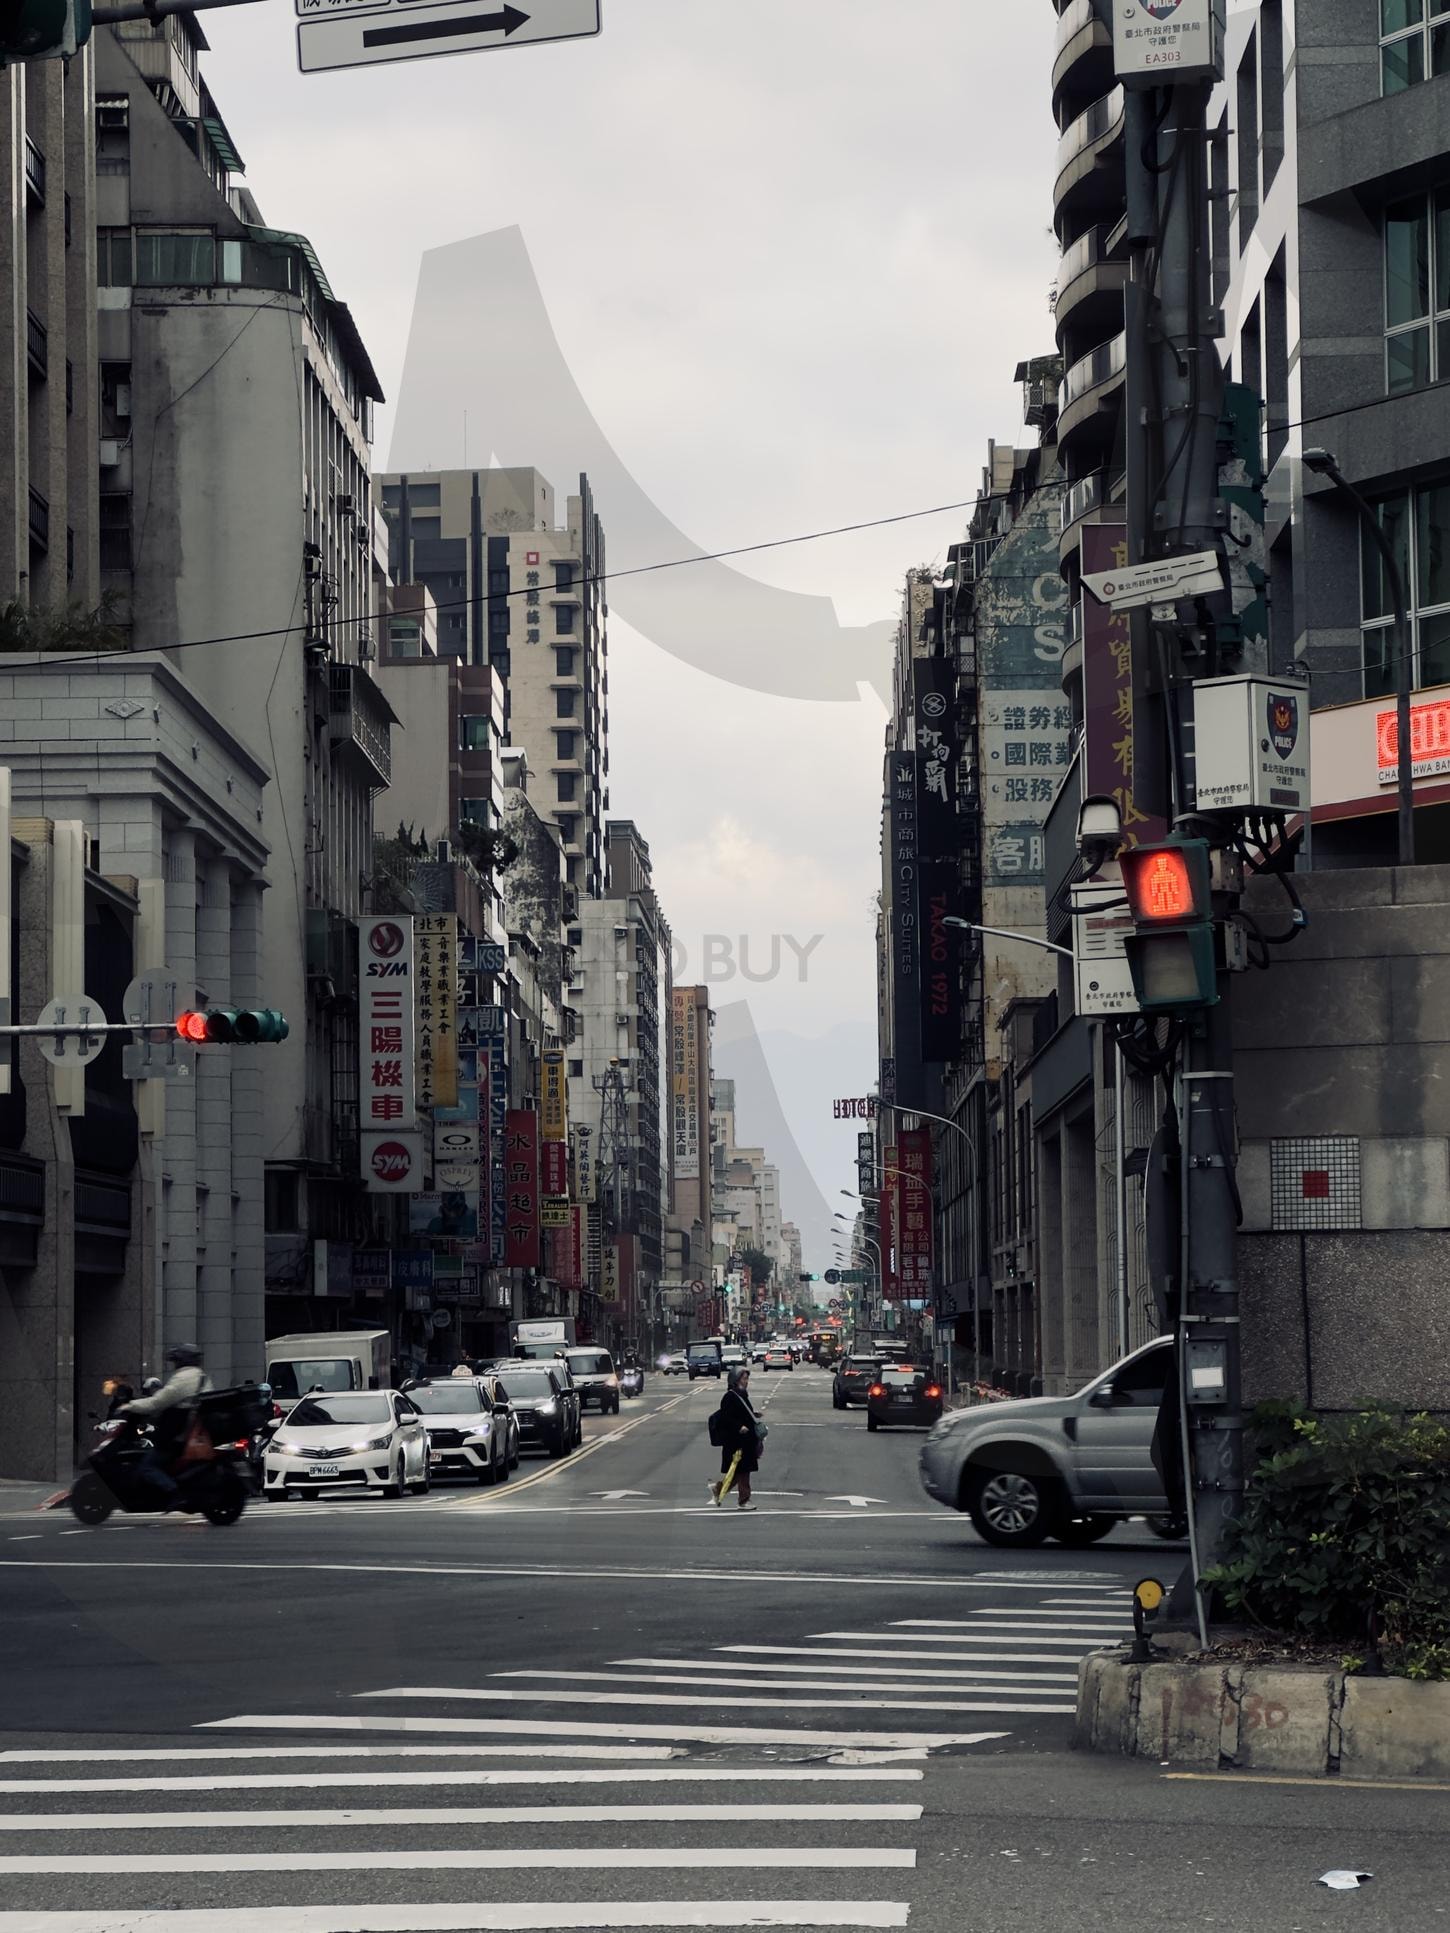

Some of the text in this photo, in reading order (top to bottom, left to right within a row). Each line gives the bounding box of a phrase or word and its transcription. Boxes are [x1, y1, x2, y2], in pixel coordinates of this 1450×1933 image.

[1145, 51, 1181, 64] EA303
[897, 789, 915, 861] 城市商旅
[366, 962, 408, 978] SYM
[478, 948, 503, 971] KSS
[930, 891, 949, 1016] TAKAO 1972
[371, 991, 403, 1121] 三陽機車
[370, 1154, 411, 1175] SYM
[508, 1133, 532, 1244] 水晶超市
